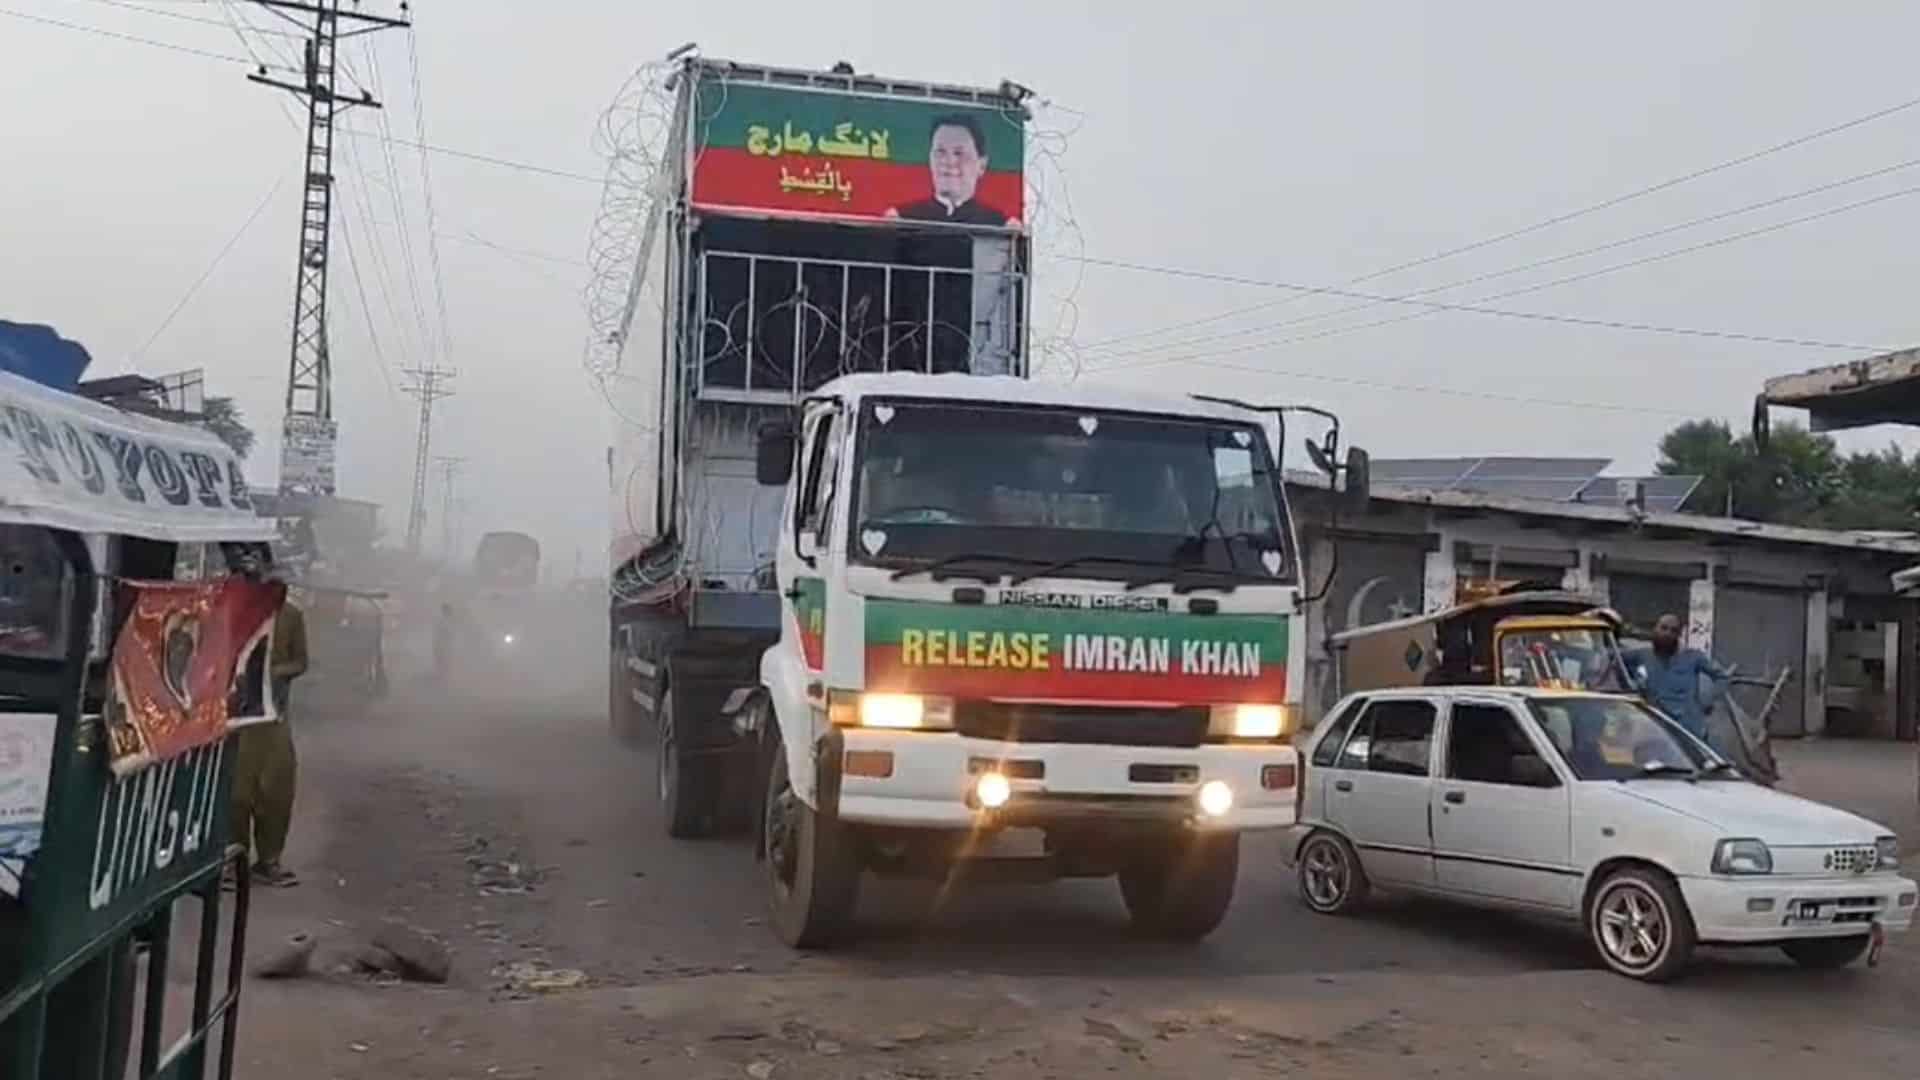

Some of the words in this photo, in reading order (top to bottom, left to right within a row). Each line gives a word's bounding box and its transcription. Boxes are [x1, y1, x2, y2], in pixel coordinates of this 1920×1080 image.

[817, 121, 889, 159] لانگ
[1000, 590, 1081, 608] NISSAN
[1091, 594, 1169, 612] DIESEL
[902, 629, 1050, 670] RELEASE
[1063, 634, 1169, 674] IMRAN
[1182, 640, 1261, 678] KHAN
